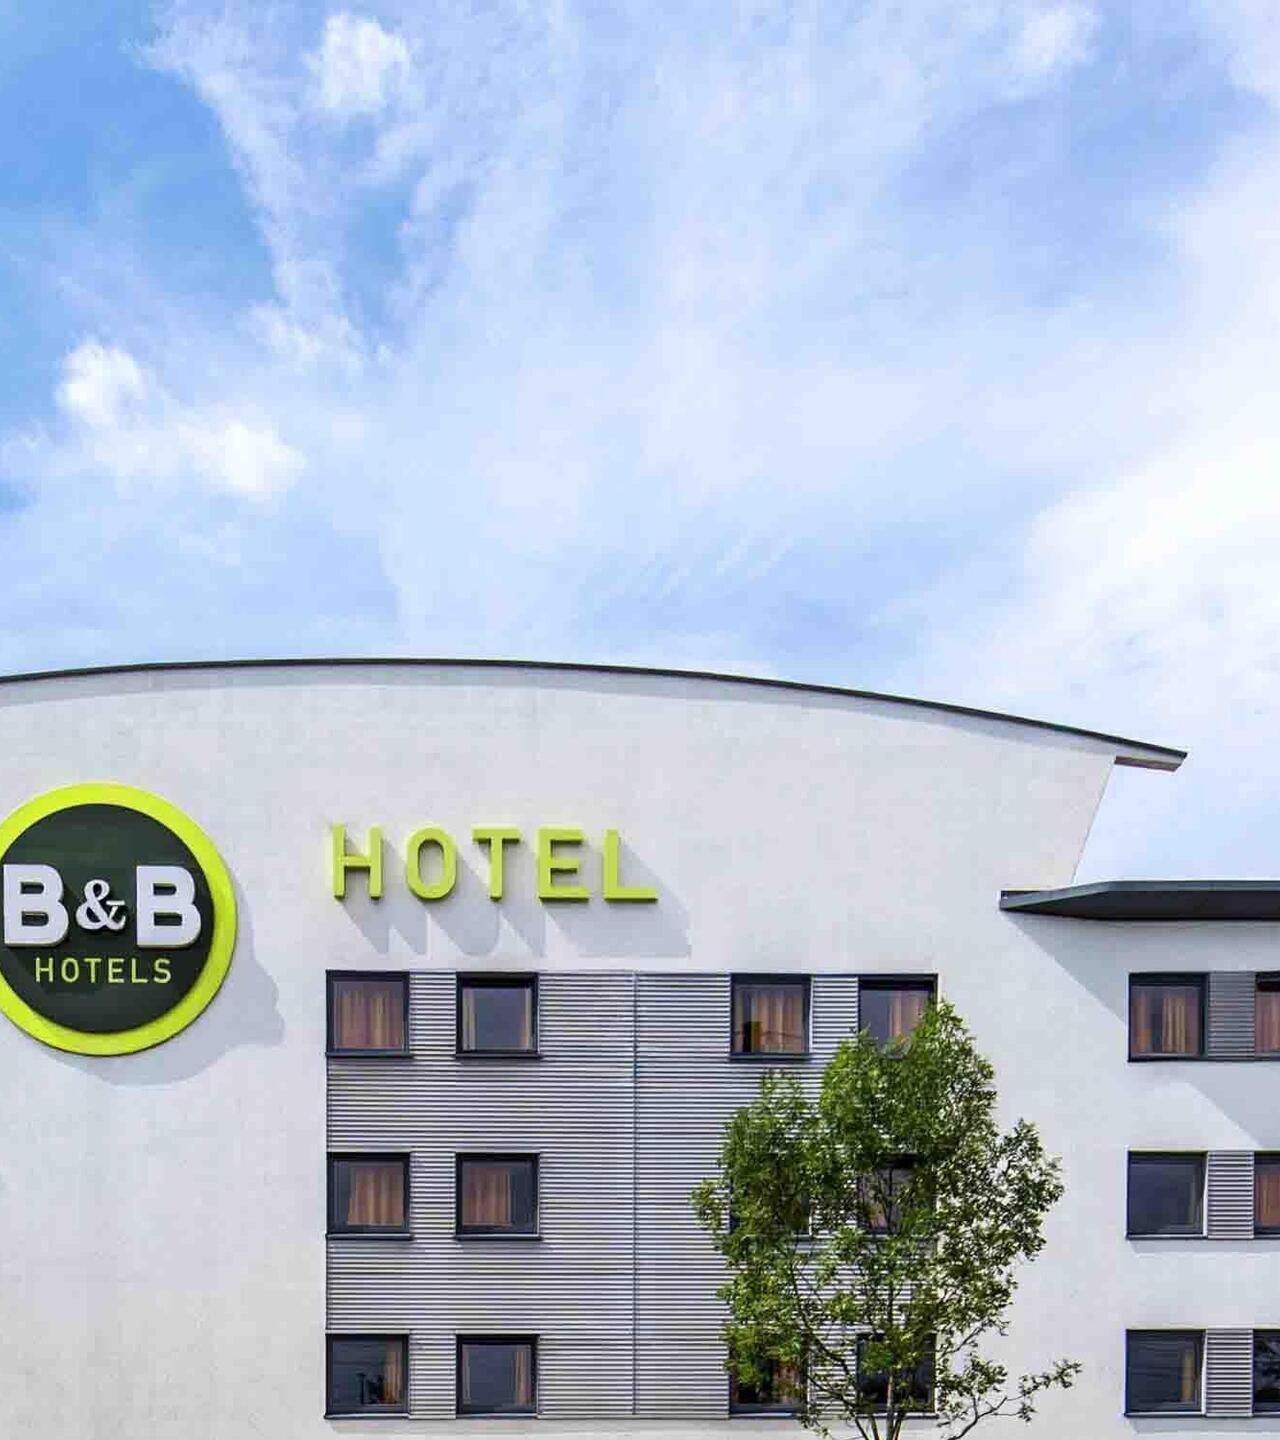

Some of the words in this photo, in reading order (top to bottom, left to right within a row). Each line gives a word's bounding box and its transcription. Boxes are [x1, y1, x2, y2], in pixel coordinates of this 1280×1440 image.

[330, 823, 658, 903] HOTEL
[3, 864, 202, 948] B&B
[34, 956, 172, 984] HOTELS
